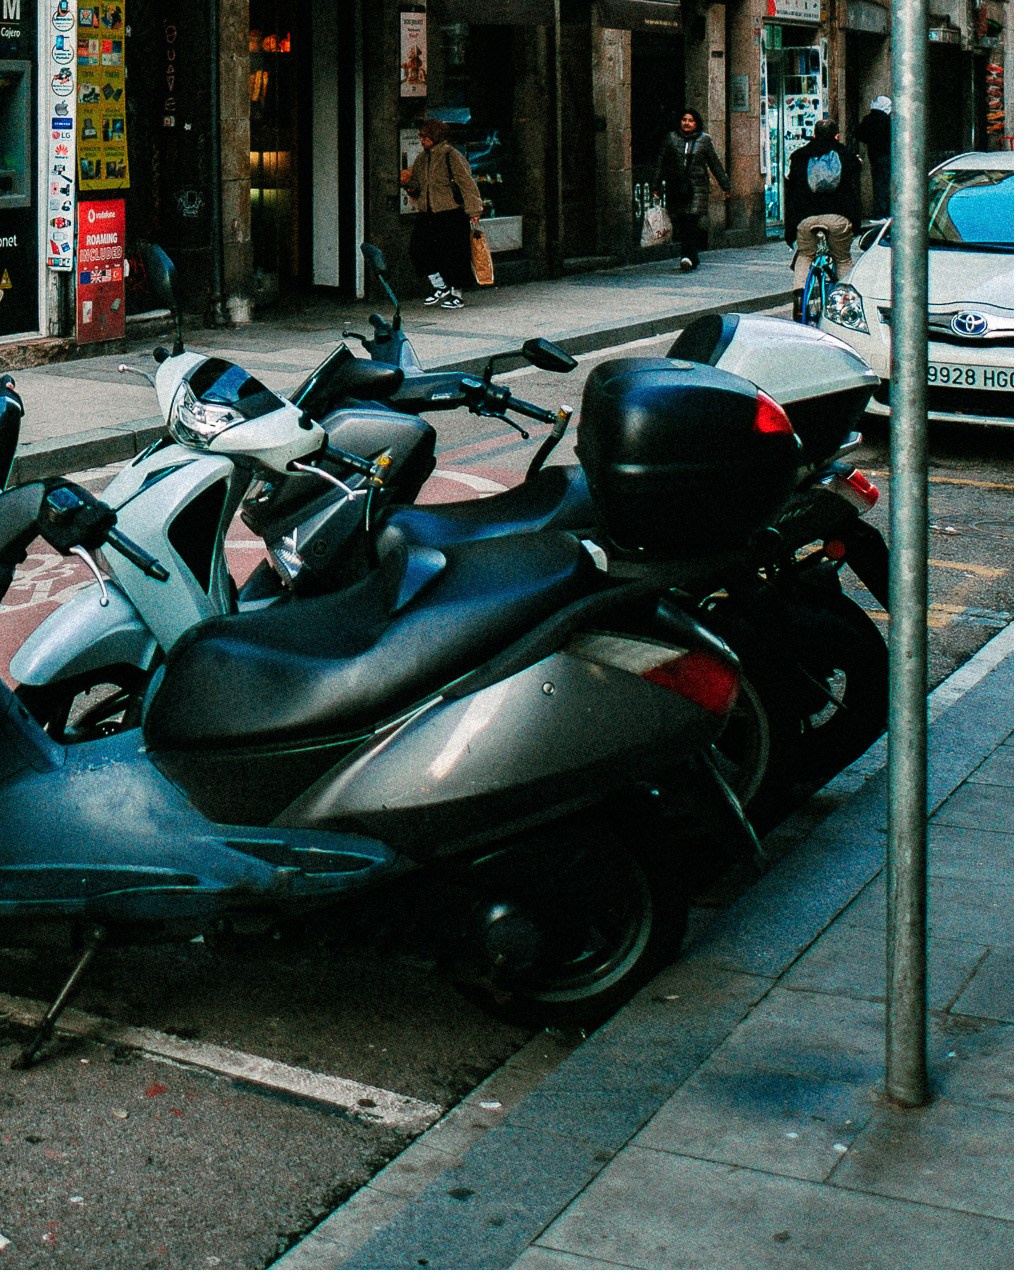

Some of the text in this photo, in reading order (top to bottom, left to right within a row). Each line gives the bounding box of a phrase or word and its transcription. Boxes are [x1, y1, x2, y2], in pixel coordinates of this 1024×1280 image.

[96, 210, 116, 219] vodafone
[86, 232, 118, 246] ROAMING
[79, 245, 123, 262] INCLUDED
[928, 365, 976, 386] 9928
